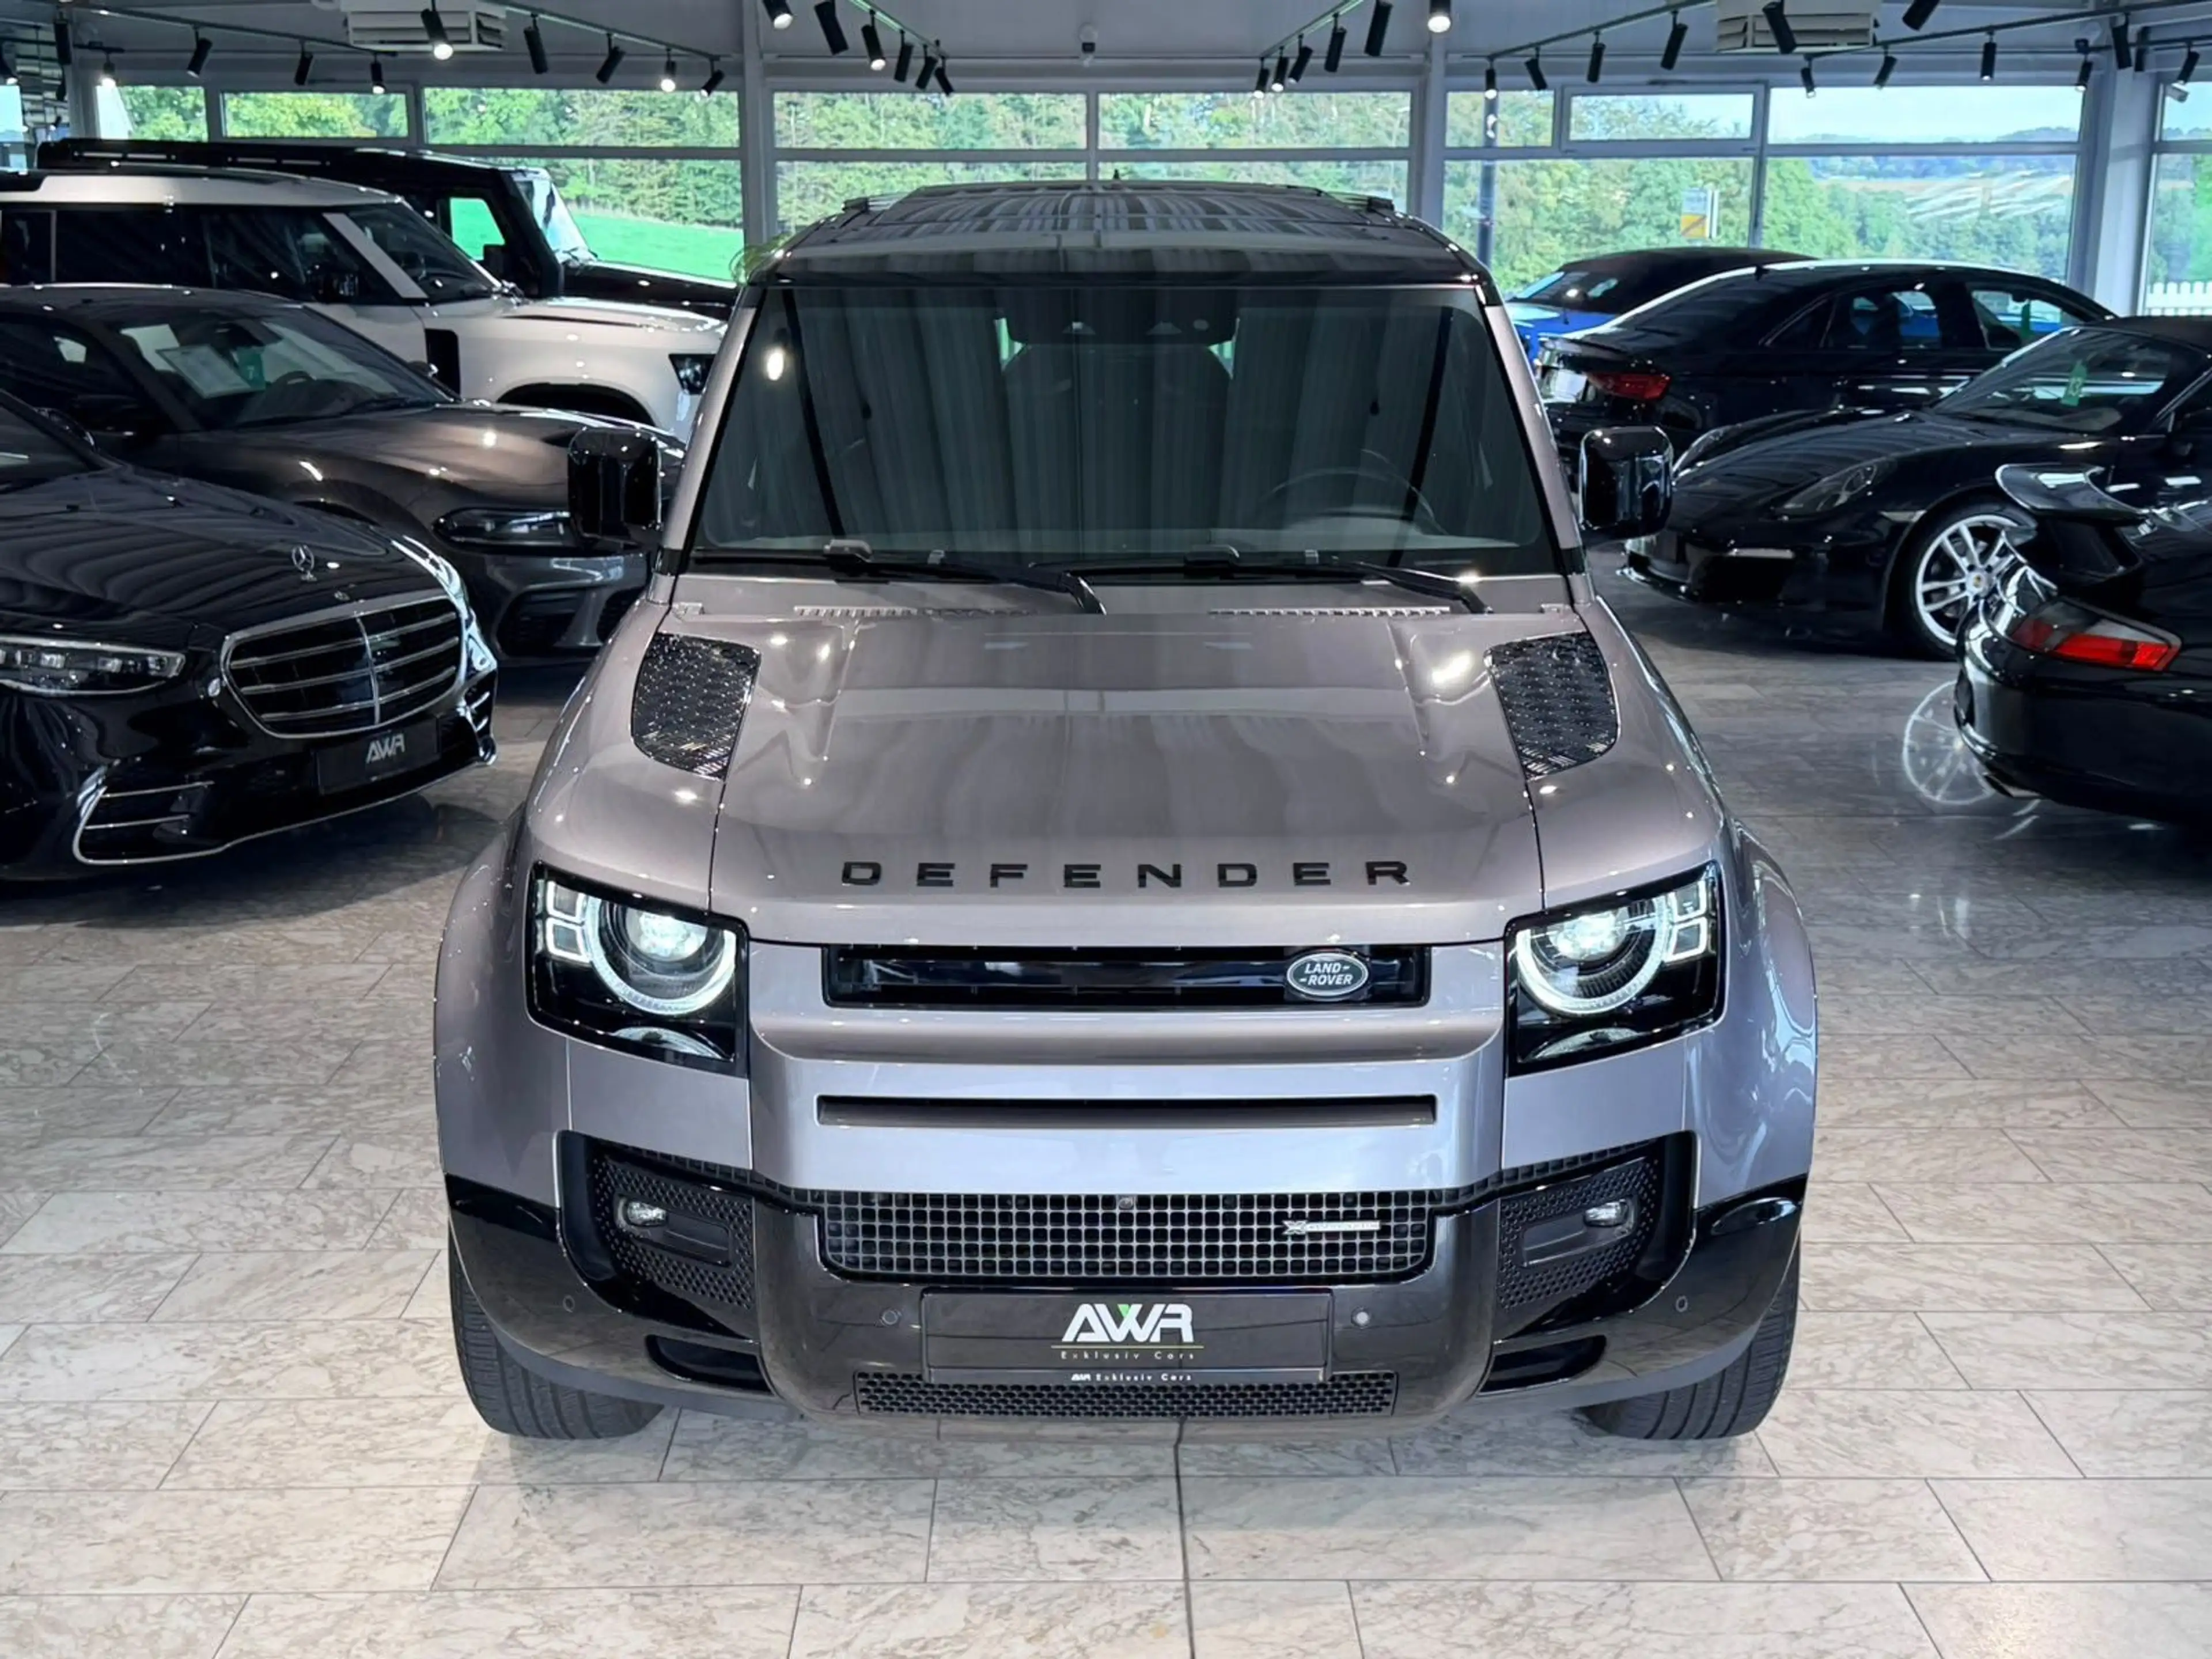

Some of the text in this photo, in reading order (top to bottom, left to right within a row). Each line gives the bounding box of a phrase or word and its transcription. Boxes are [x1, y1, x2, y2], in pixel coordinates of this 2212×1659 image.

[842, 861, 1411, 888] DEFENDER
[1061, 1303, 1194, 1343] AWR
[1060, 1351, 1194, 1359] Exklusiv Cars
